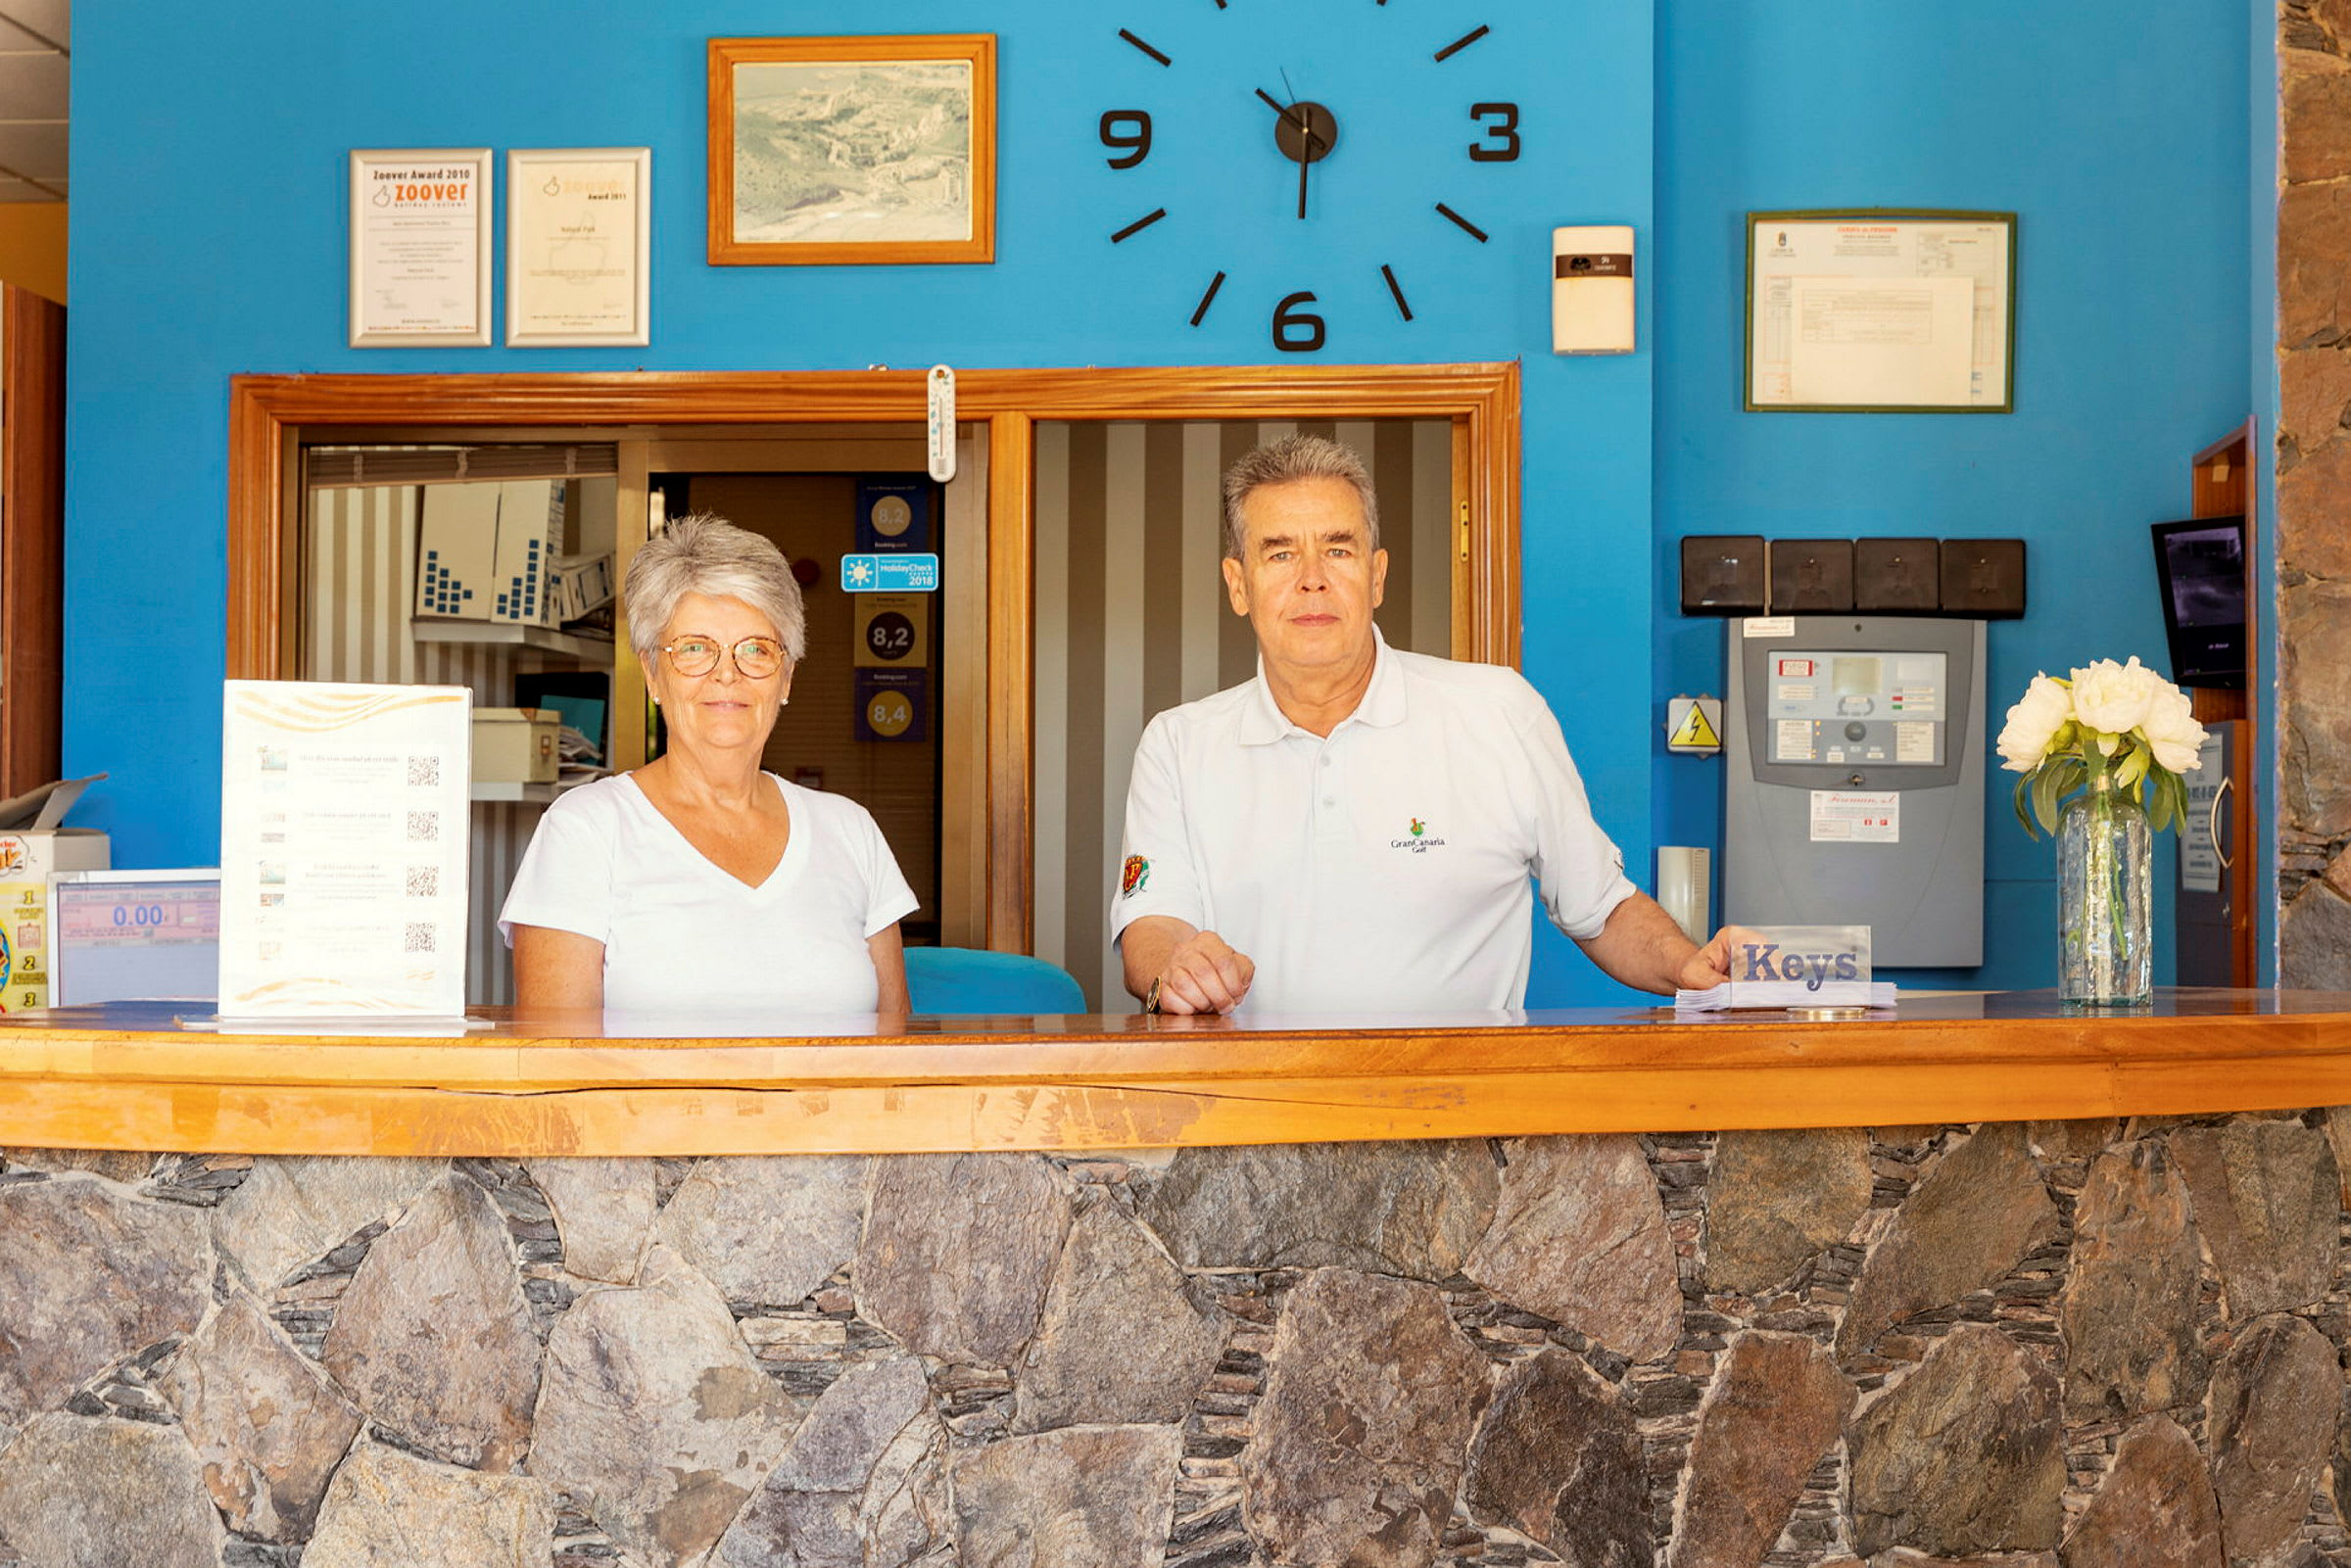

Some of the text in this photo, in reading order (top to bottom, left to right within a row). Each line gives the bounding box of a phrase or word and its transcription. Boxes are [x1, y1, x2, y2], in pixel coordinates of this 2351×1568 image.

[1099, 110, 1152, 169] 9
[1469, 103, 1520, 162] 3
[373, 169, 470, 180] Zoover Award 2010
[395, 183, 468, 202] zoover
[1272, 292, 1325, 352] 6
[880, 563, 934, 574] HolidayCheck
[908, 576, 934, 587] 2018
[873, 627, 909, 649] 8,2
[873, 705, 907, 725] 8,4
[24, 890, 35, 905] 1
[113, 904, 164, 927] 0.00
[24, 955, 36, 971] 2
[1743, 944, 1857, 992] Keys
[24, 992, 37, 1008] 3
